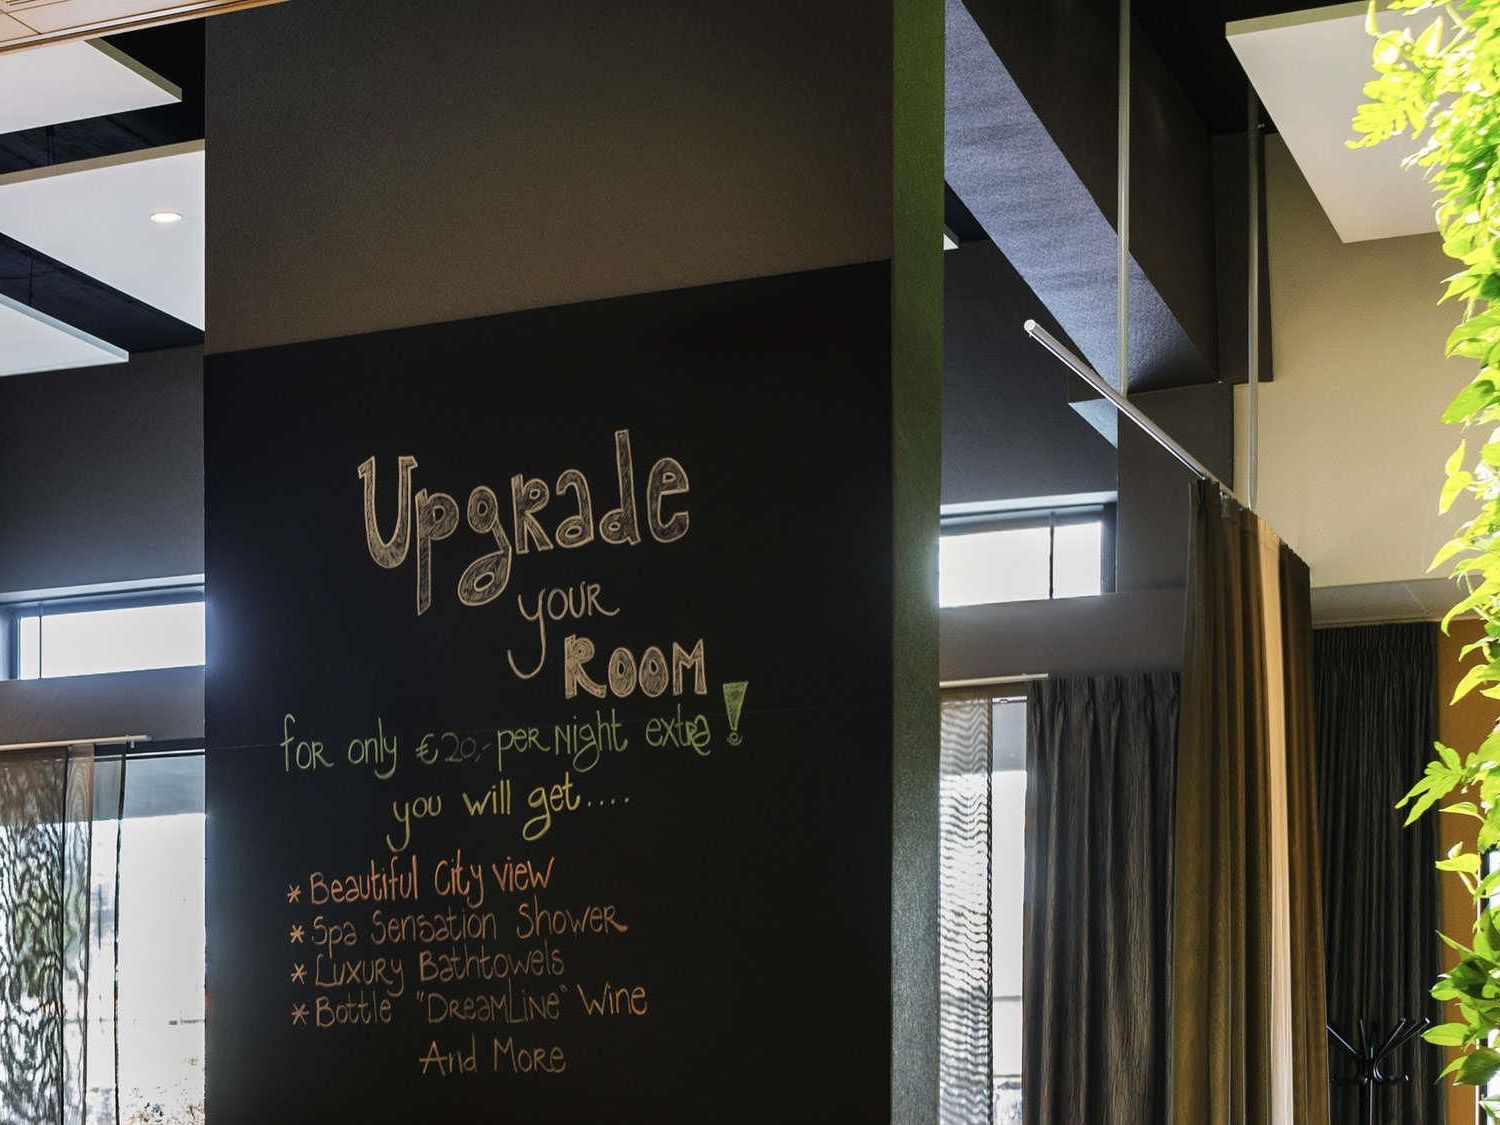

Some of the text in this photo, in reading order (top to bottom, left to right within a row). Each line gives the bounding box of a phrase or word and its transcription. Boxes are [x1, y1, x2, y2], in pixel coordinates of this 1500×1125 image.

[358, 429, 689, 614] Upgrade
[564, 635, 708, 699] ROOM
[347, 717, 398, 779] only
[387, 794, 442, 852] you
[462, 780, 512, 815] will
[309, 854, 418, 905] Beautiful
[433, 849, 484, 909] City
[311, 915, 357, 958] Spa
[371, 905, 498, 945] Sensation
[419, 942, 565, 983] Bathtowels
[315, 991, 393, 1028] Bottle
[577, 983, 649, 1017] Wine
[419, 1031, 478, 1076] And
